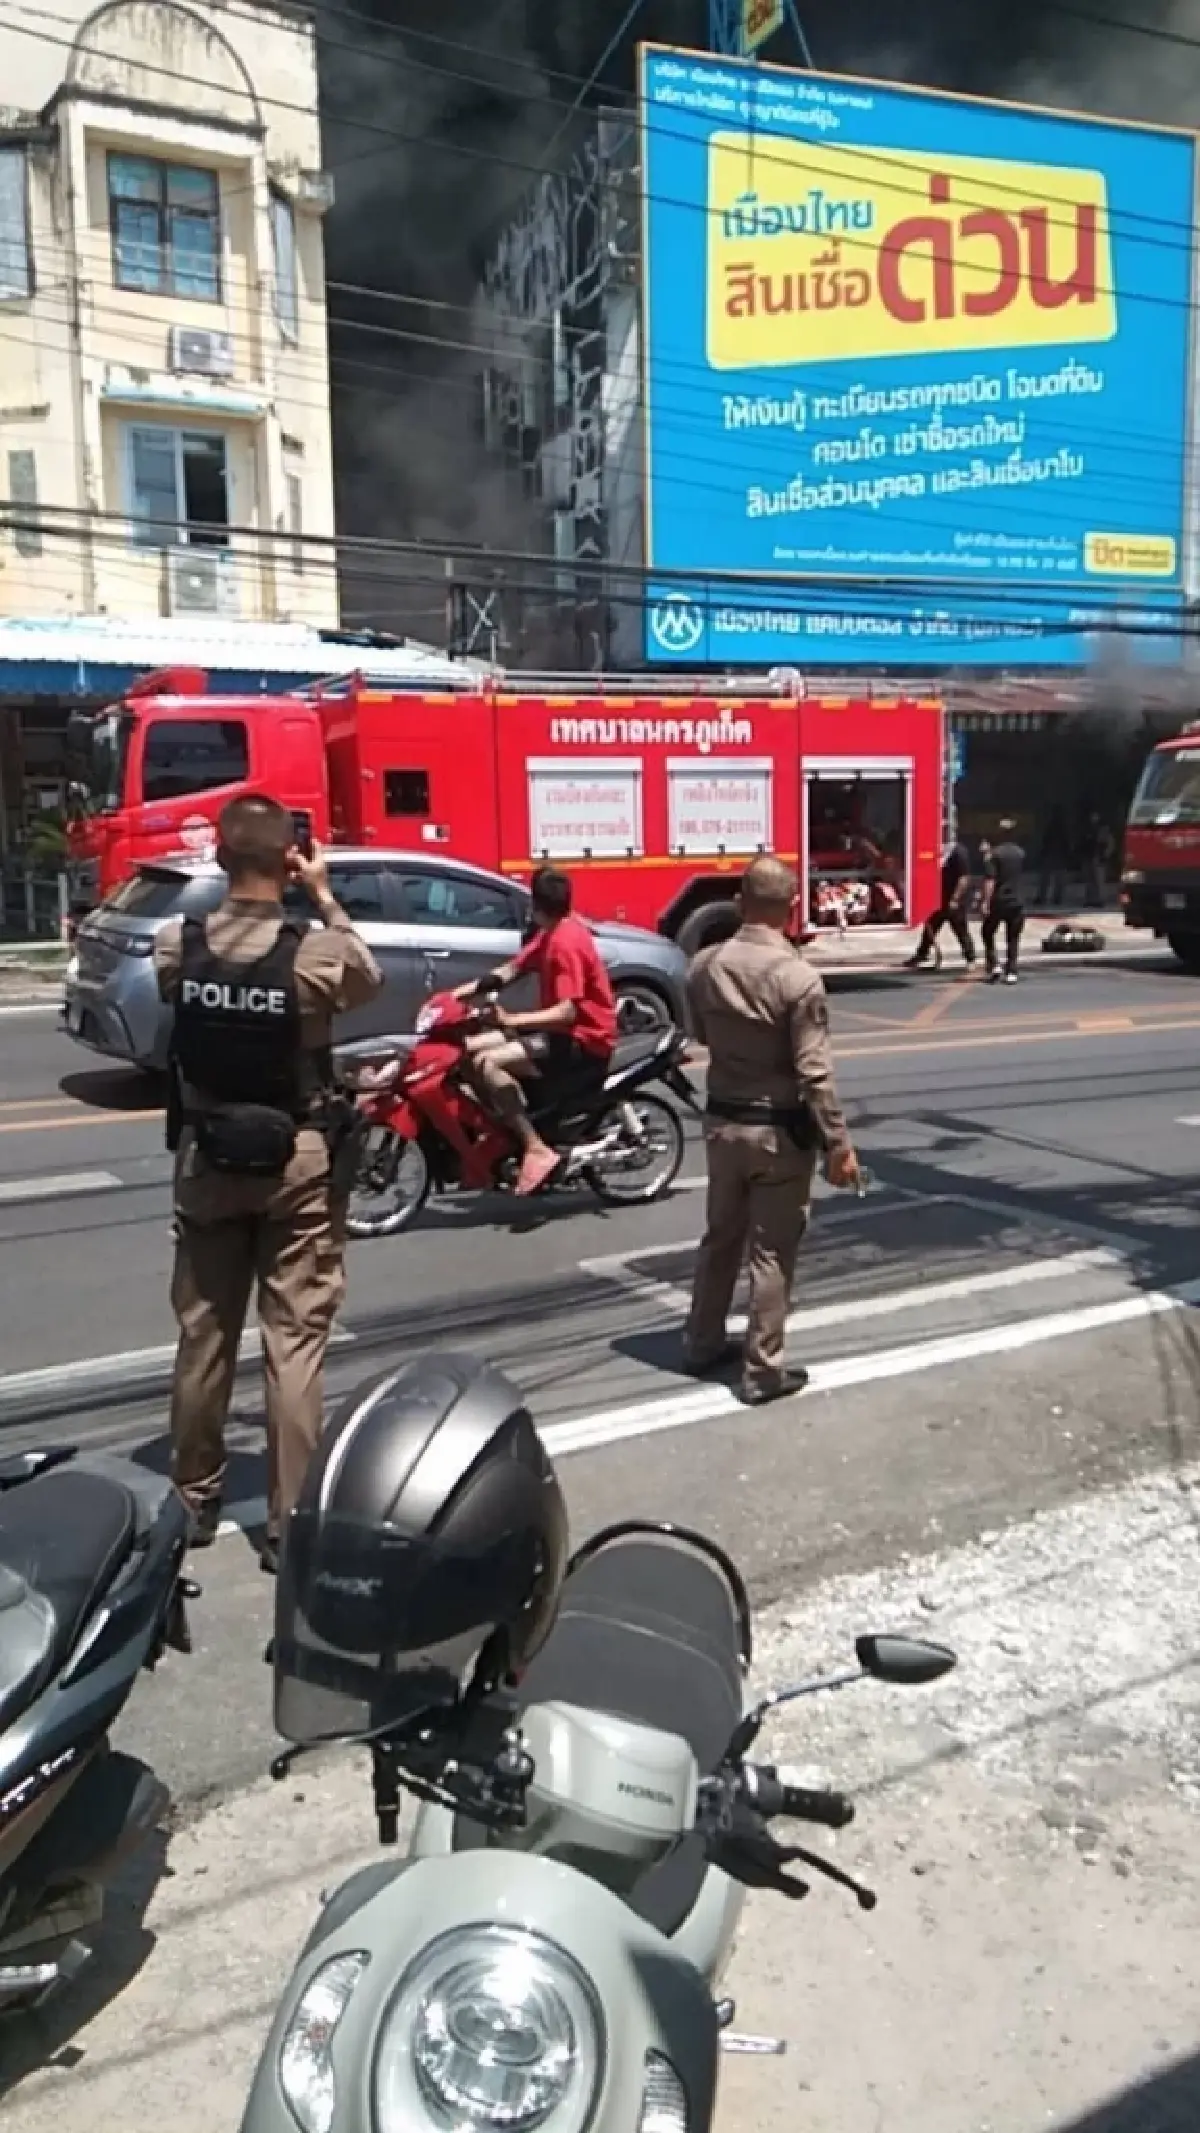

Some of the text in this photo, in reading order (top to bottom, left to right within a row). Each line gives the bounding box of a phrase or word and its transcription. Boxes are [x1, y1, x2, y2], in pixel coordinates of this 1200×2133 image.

[722, 189, 874, 238] เมืองไทย
[724, 172, 1097, 324] สินเชื่อ ด่วน
[722, 388, 807, 431] ให้เงินกู้
[812, 374, 1001, 420] ทะเบียนรถทุกชนิด
[812, 404, 1026, 466] คอนโด เช่าซื้อรถใหม่
[745, 471, 926, 518] สินเชื่อส่วนบุคคล
[551, 708, 753, 754] เทศบาลนครภูเก็ต
[182, 980, 286, 1015] POLICE
